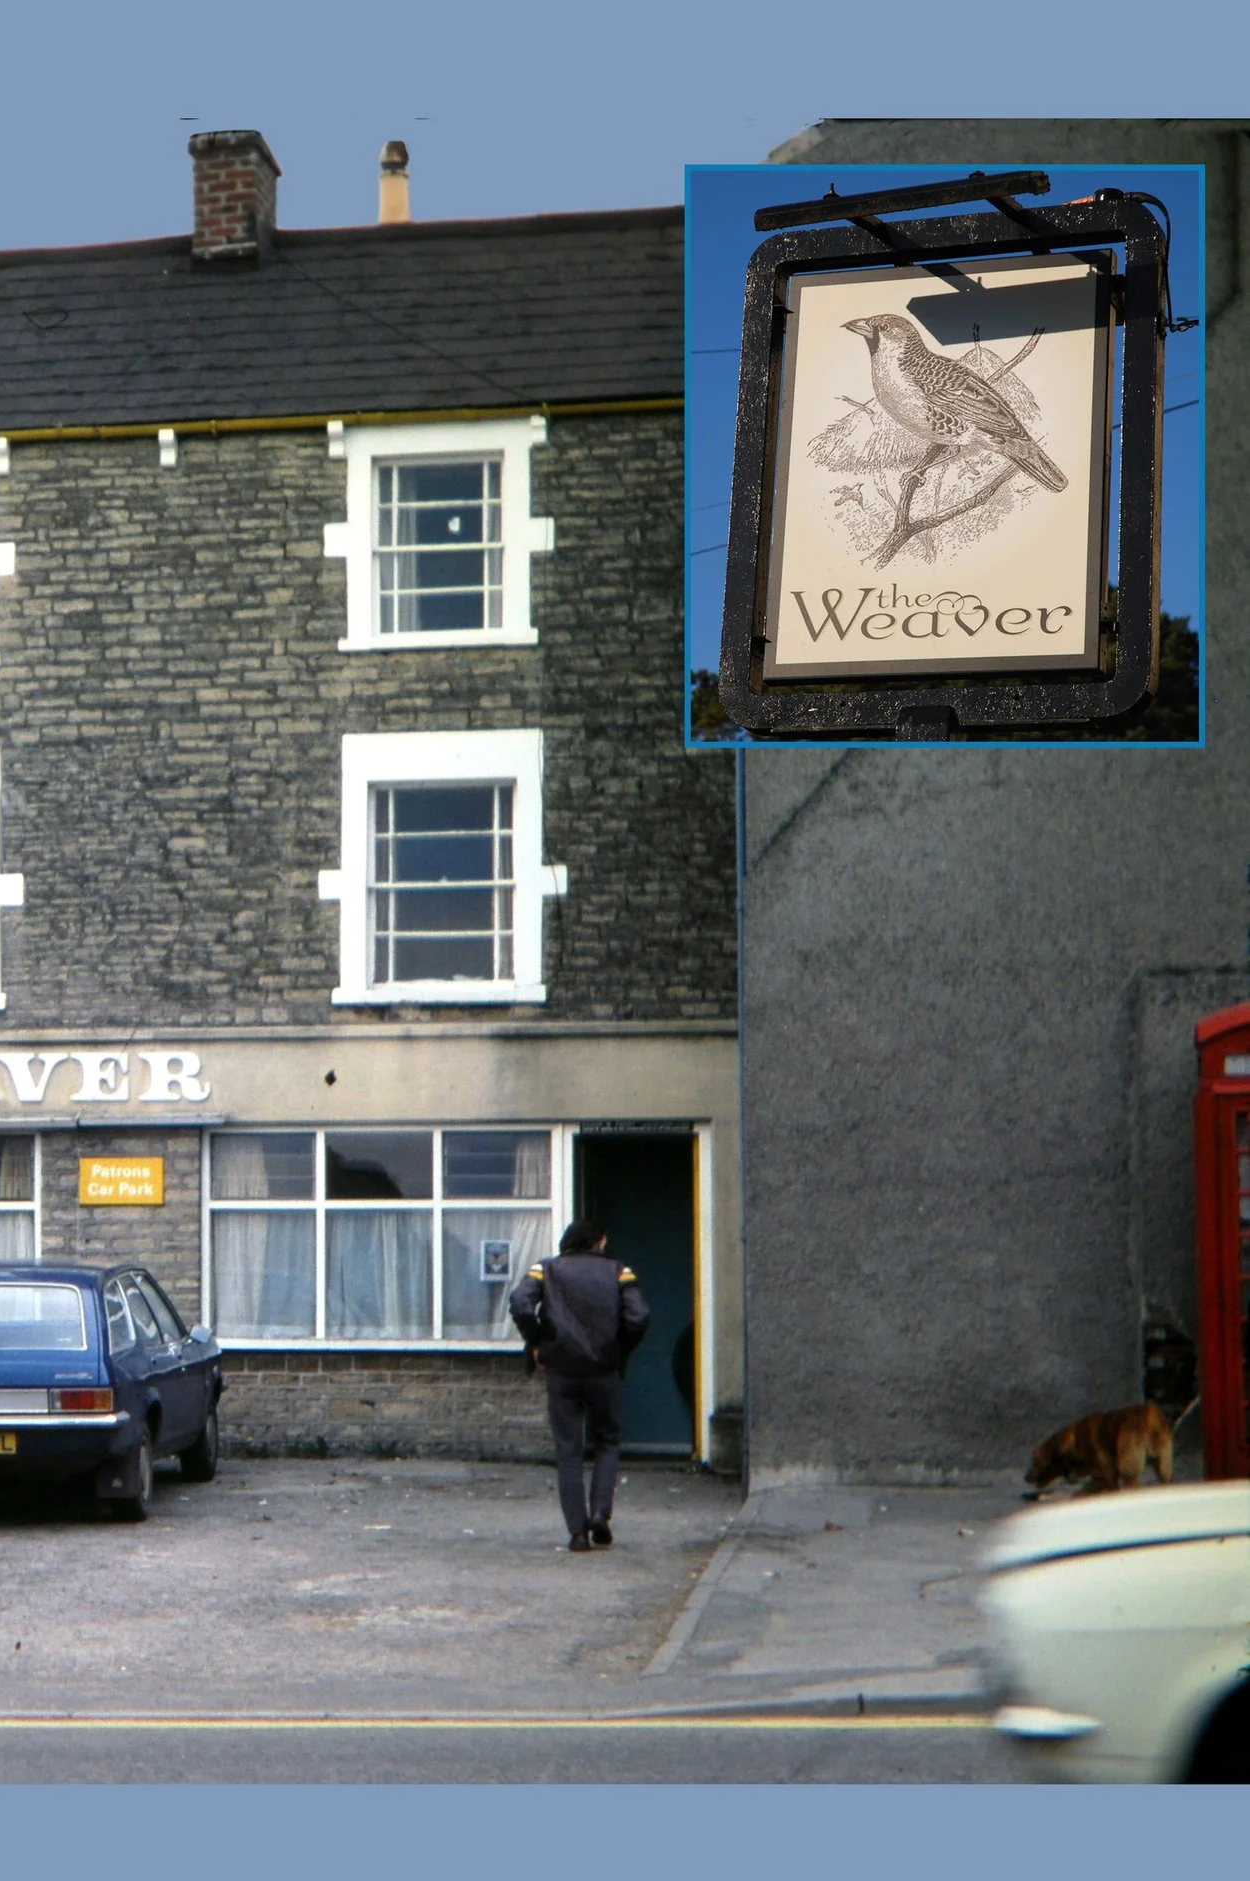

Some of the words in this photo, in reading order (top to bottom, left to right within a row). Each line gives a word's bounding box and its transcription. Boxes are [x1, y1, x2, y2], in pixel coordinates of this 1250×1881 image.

[876, 583, 933, 609] the
[789, 587, 1073, 643] Weaver
[91, 1164, 151, 1178] Patrons
[87, 1182, 115, 1196] Car
[118, 1182, 154, 1196] Park
